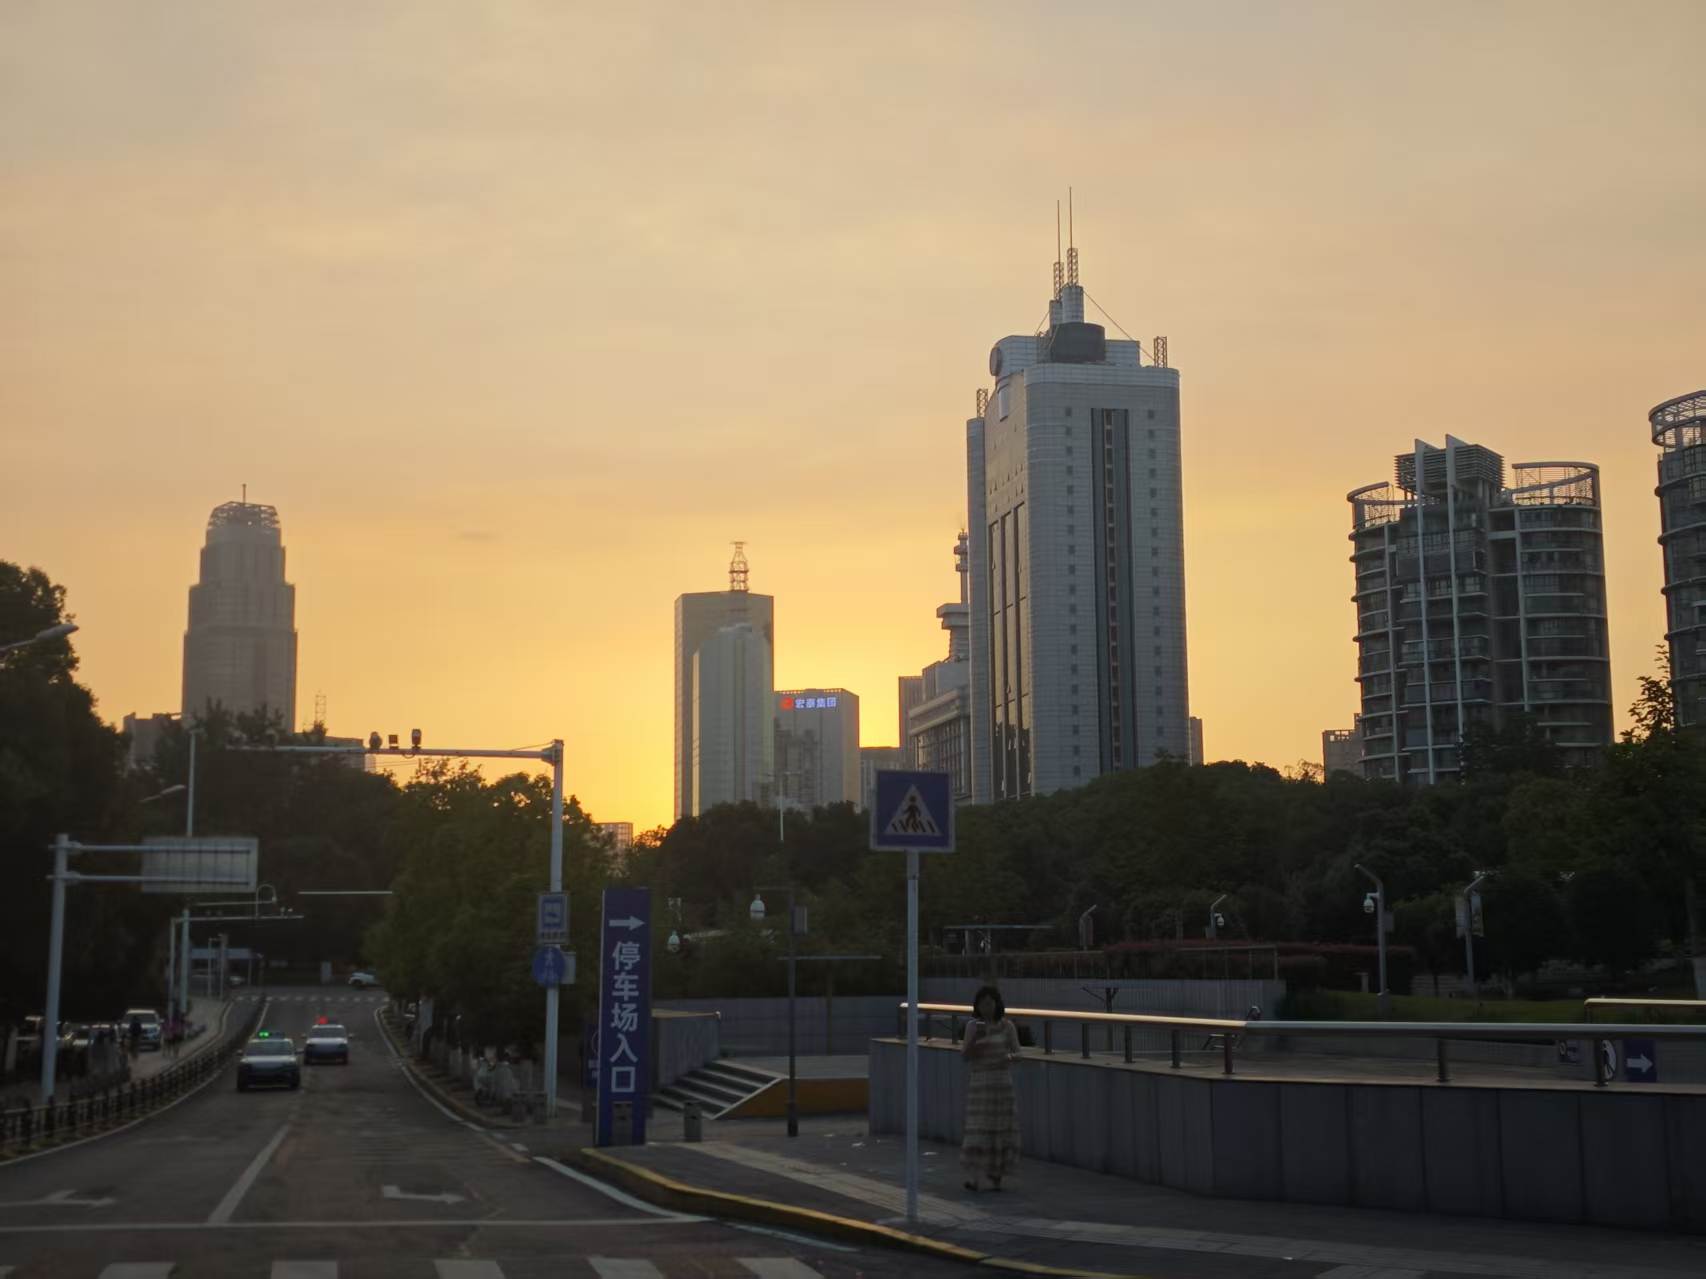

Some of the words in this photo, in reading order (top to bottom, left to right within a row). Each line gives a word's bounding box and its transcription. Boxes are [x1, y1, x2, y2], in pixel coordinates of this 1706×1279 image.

[610, 940, 641, 1093] 停车场入口
